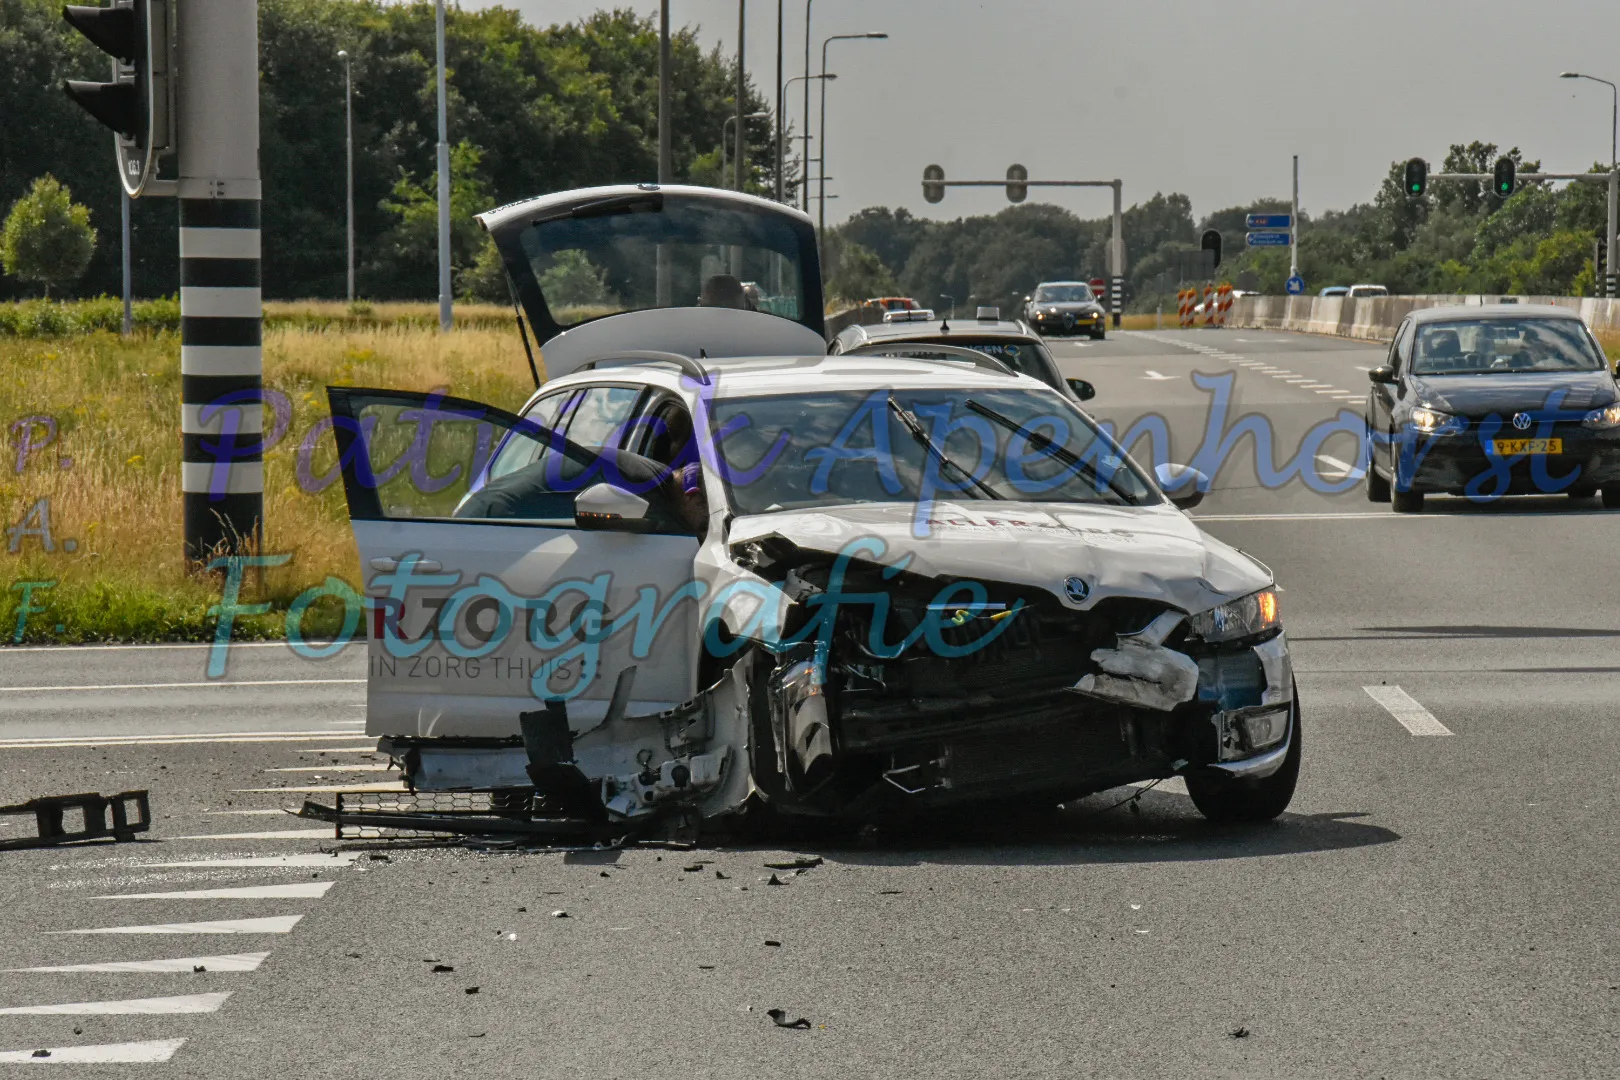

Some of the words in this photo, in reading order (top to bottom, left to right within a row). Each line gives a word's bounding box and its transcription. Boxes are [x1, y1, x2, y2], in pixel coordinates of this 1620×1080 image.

[370, 655, 396, 677] IN
[408, 656, 480, 679] ZORG
[490, 657, 571, 680] THUIS
